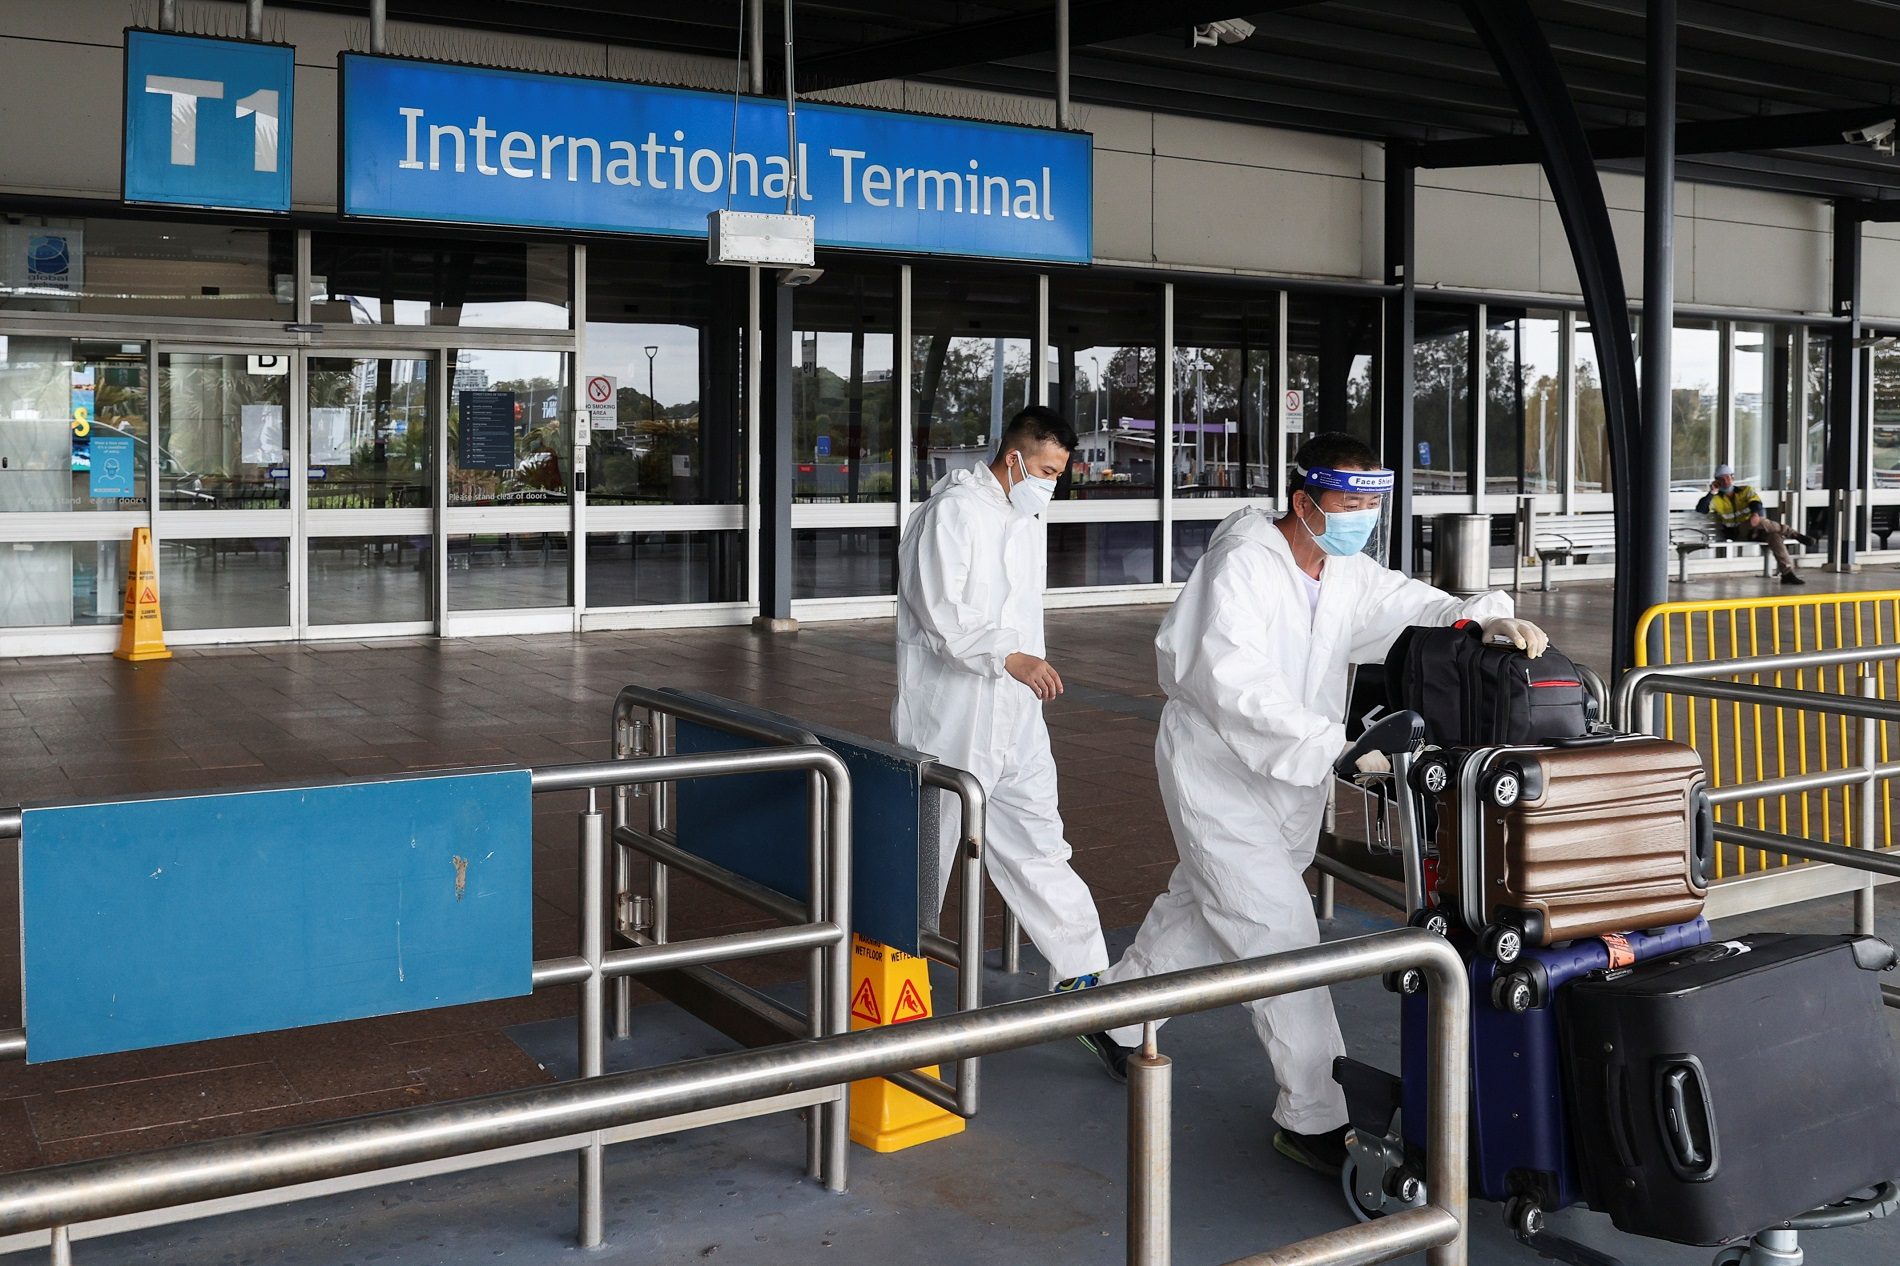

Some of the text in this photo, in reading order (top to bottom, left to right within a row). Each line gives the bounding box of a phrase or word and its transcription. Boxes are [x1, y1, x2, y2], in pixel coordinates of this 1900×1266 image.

[145, 75, 279, 172] T1
[399, 107, 1055, 221] International Terminal
[1355, 478, 1376, 486] Face
[118, 496, 145, 505] doors
[448, 491, 547, 501] Please stand clear of doors
[855, 945, 883, 962] WET FLOOR
[891, 951, 903, 962] WET
